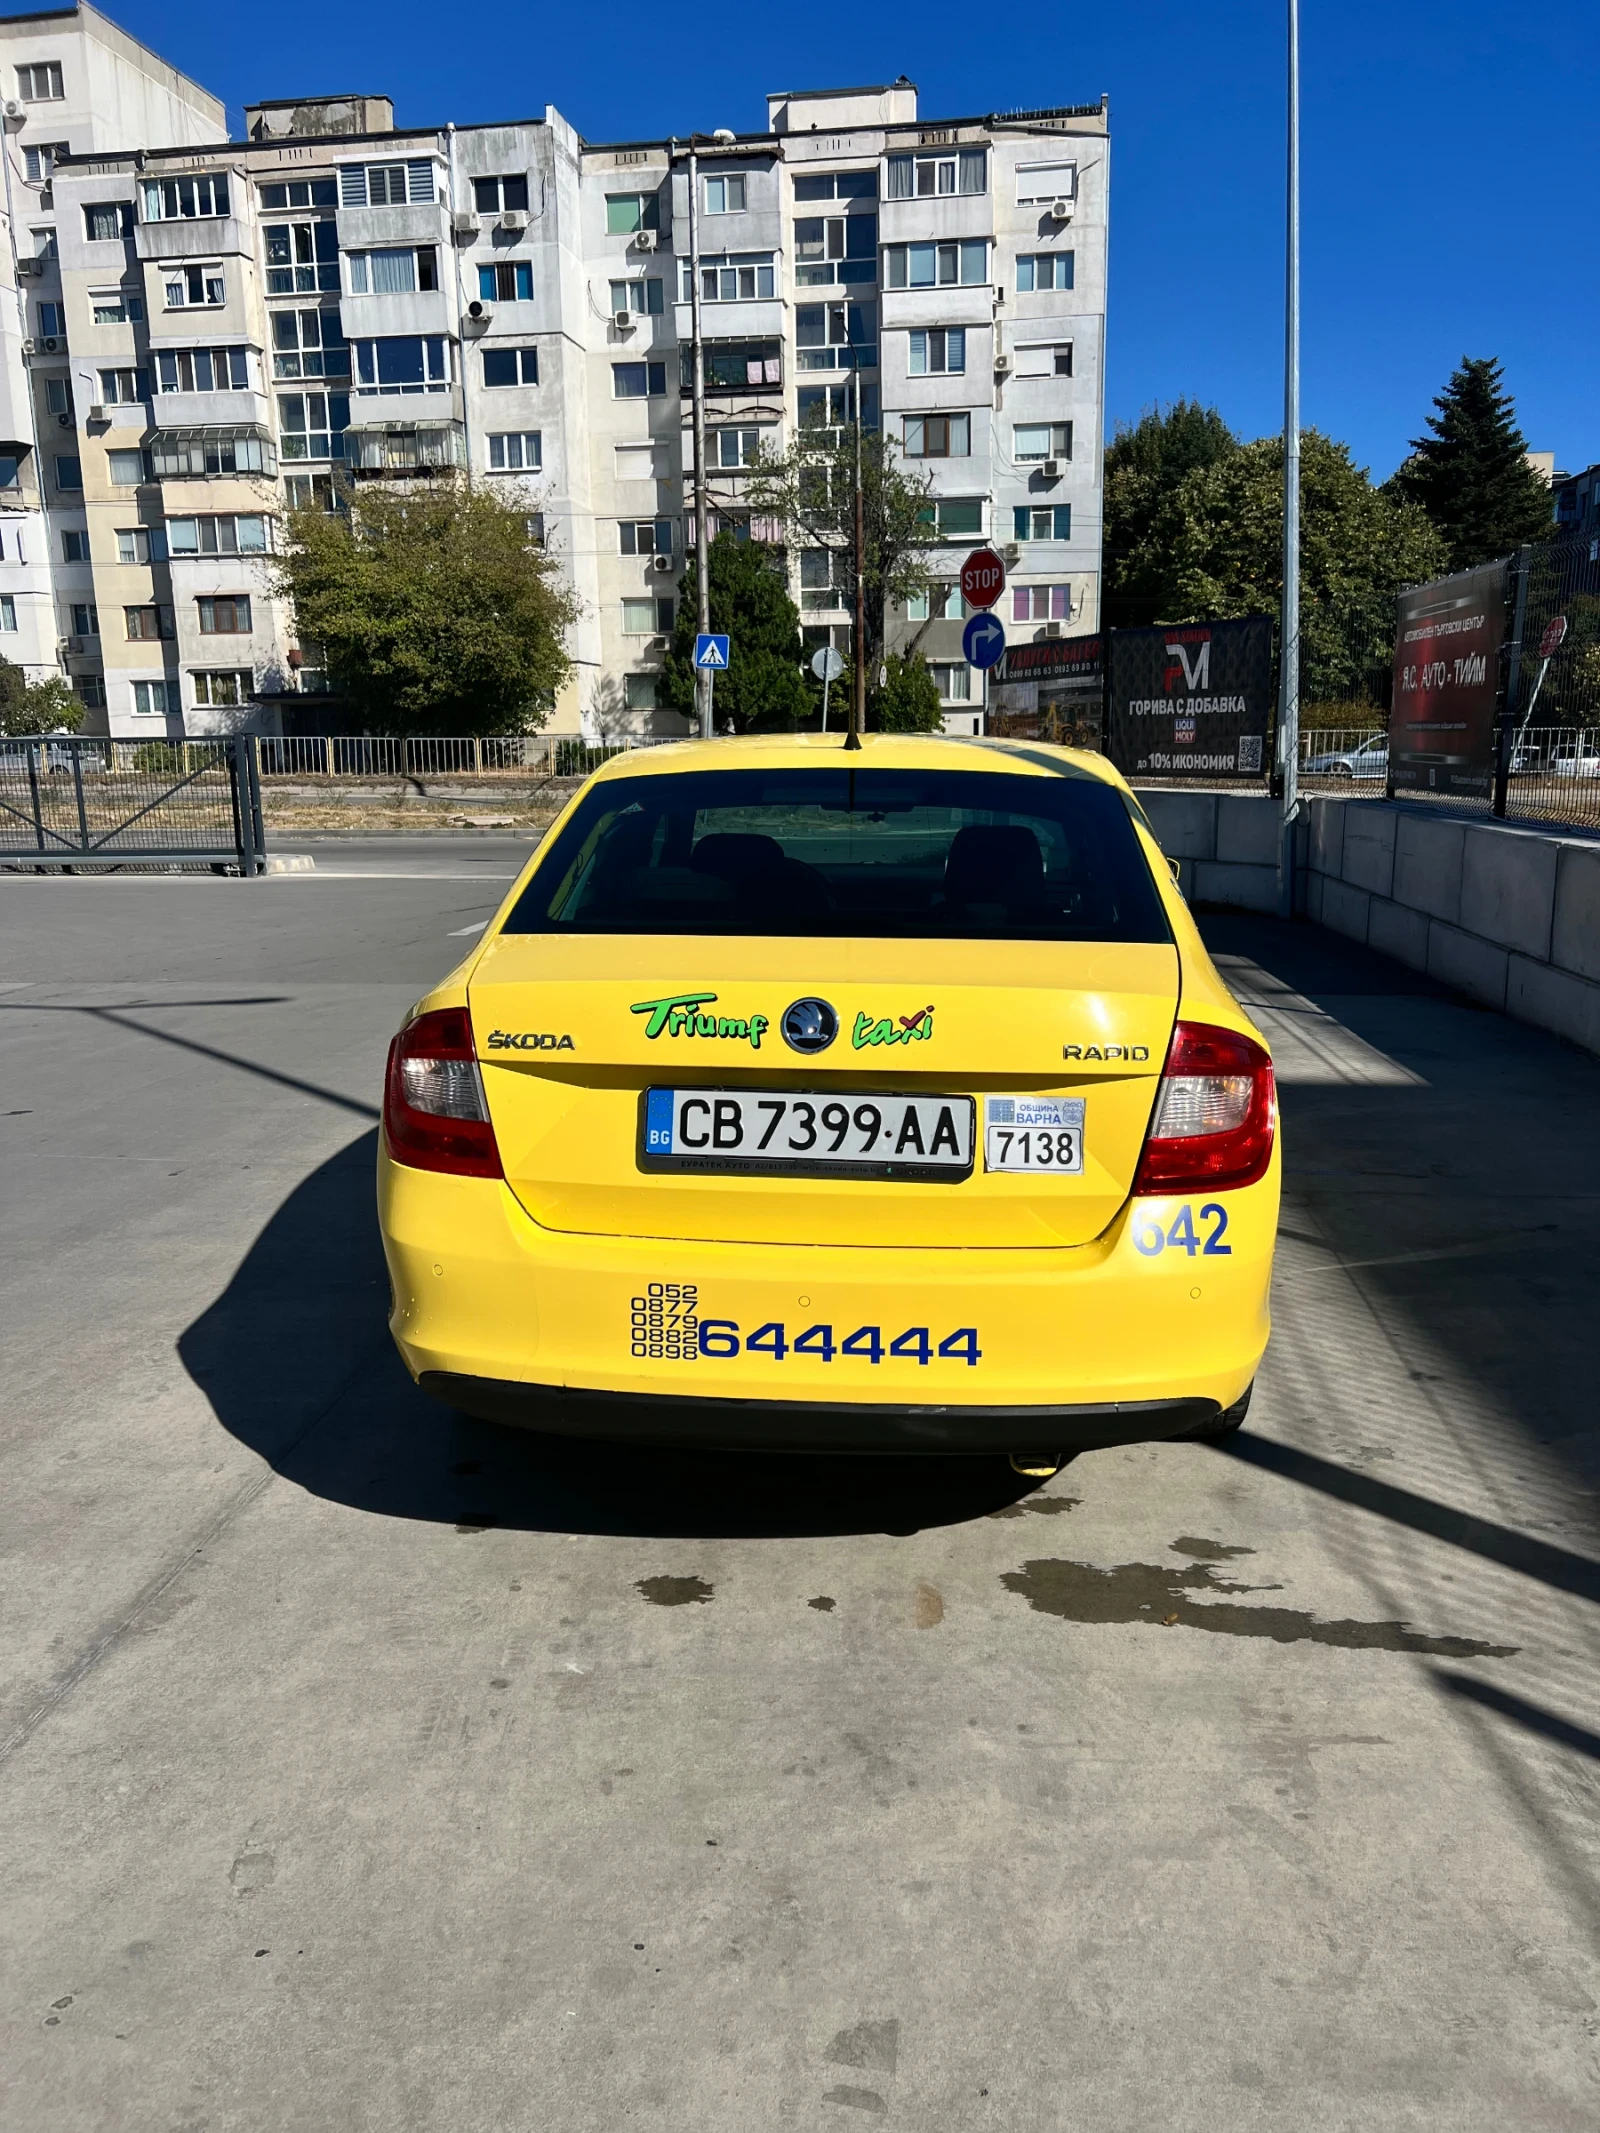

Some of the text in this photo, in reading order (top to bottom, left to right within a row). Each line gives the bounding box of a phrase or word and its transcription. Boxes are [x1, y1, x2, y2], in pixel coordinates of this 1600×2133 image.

[965, 568, 1000, 590] STOP
[1462, 615, 1485, 633] ЦЕНТЪР
[1421, 661, 1446, 689] АУТО
[1454, 651, 1486, 687] ТИЙМ
[1129, 695, 1246, 717] ГОРИВА С ДОБАВКА
[1175, 720, 1194, 731] LIQUI
[1175, 731, 1195, 742] MOLY
[1137, 752, 1235, 771] до 10% ИКОНОМИЯ
[631, 992, 936, 1050] Triumf taxi
[487, 1030, 576, 1051] ŠKODA
[1062, 1044, 1150, 1062] RAPID
[1019, 1104, 1059, 1113] ОБЩИНА
[1016, 1112, 1061, 1125] ВАРНА
[649, 1130, 670, 1145] BG
[997, 1131, 1074, 1165] 7138
[1131, 1203, 1232, 1257] 642
[647, 1282, 698, 1300] 052
[630, 1297, 698, 1314] 0877
[631, 1312, 698, 1329] 0879
[631, 1327, 698, 1345] 0882
[698, 1319, 983, 1367] 644444
[631, 1342, 698, 1360] 0898
